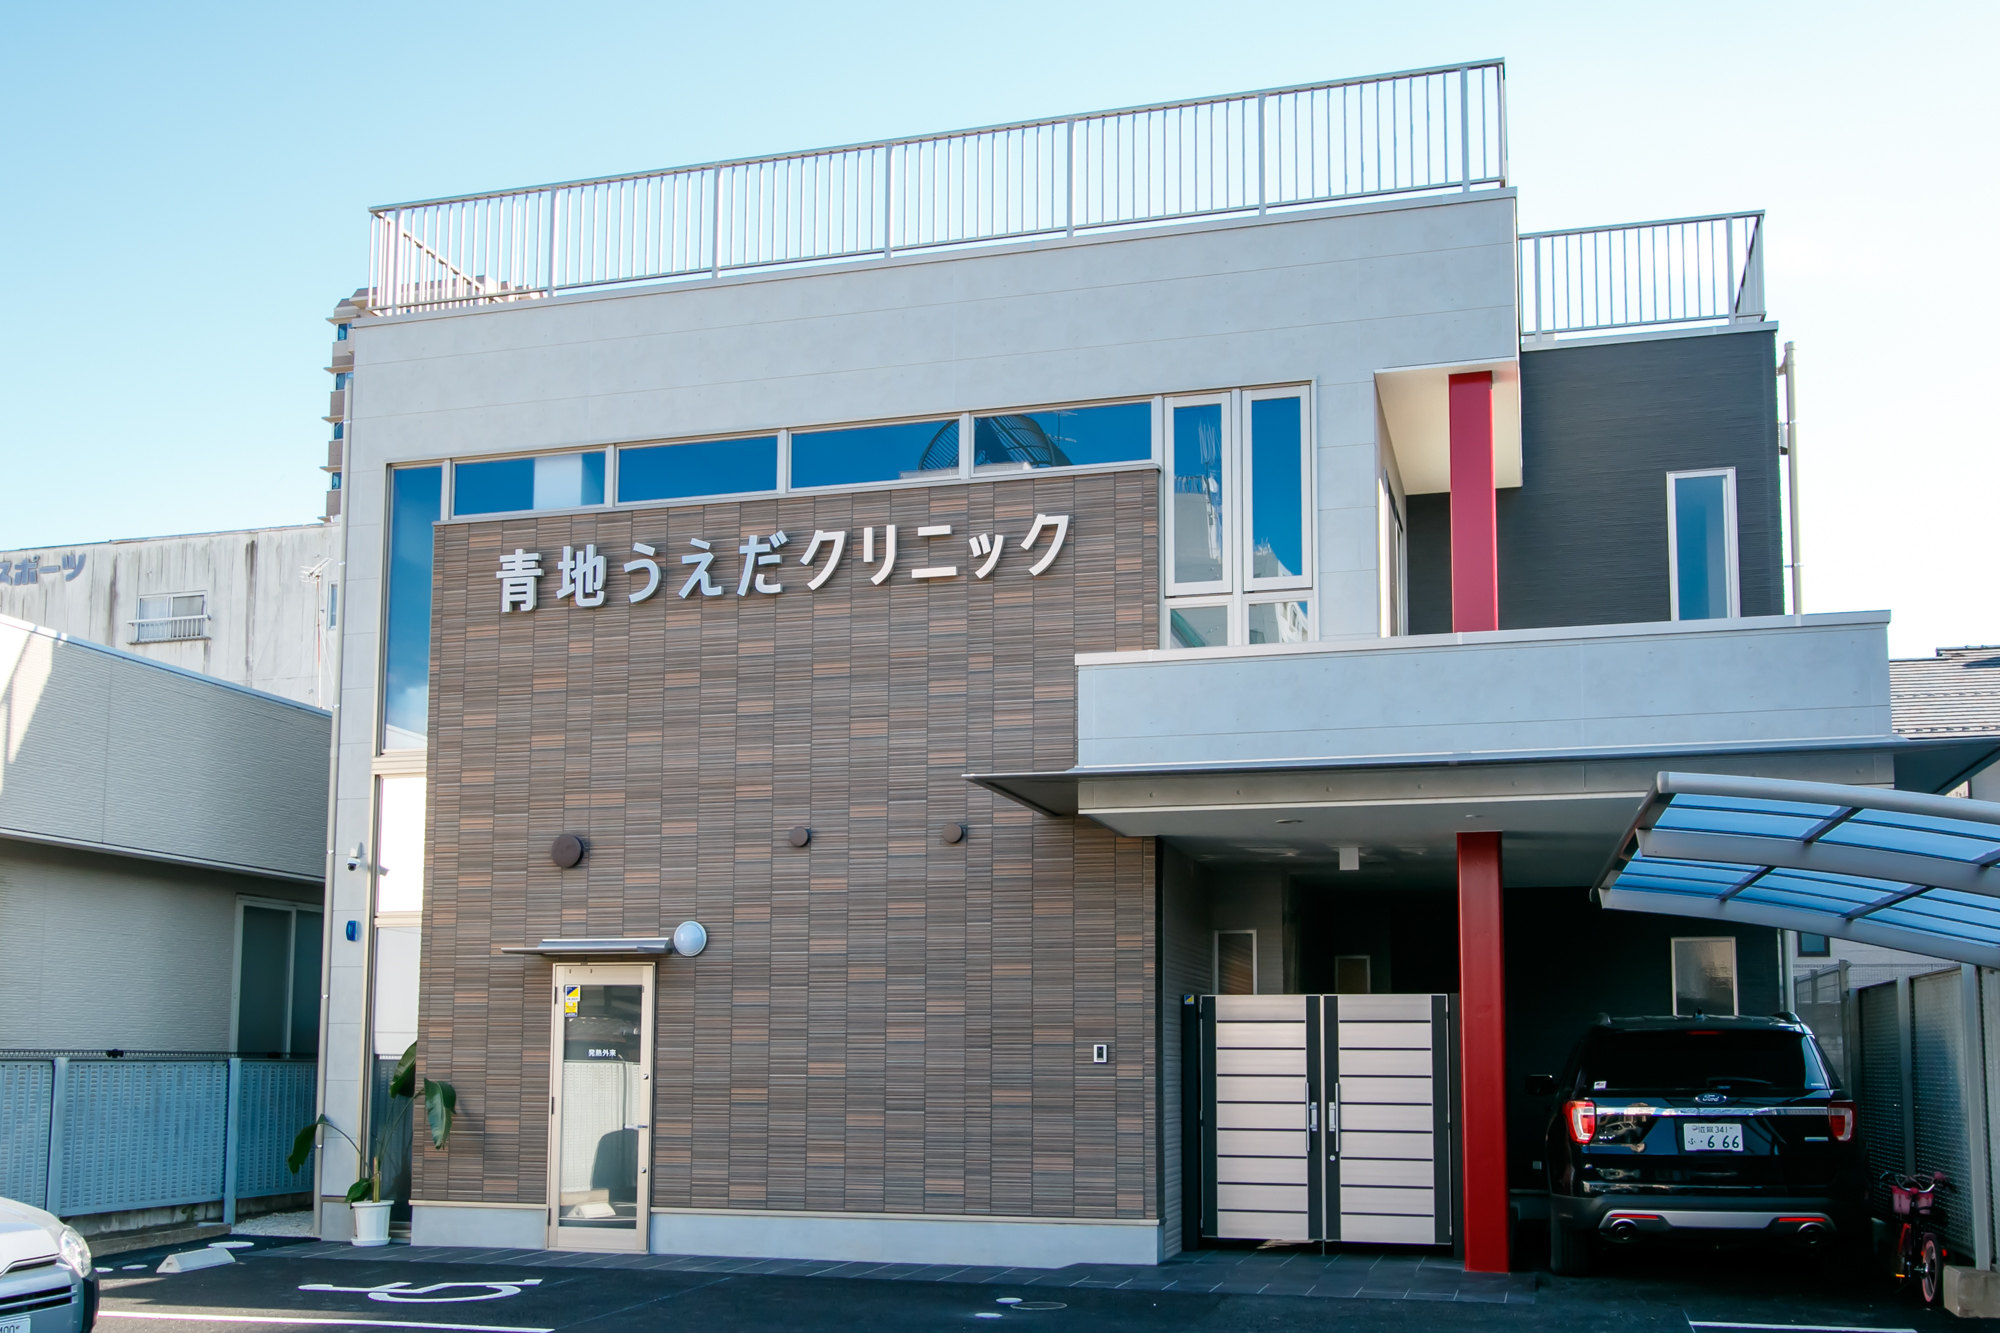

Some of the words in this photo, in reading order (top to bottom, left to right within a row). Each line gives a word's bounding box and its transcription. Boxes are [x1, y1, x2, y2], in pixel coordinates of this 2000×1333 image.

[496, 513, 1072, 614] 青地うえだクリニック
[588, 1049, 616, 1057] 発熱外来
